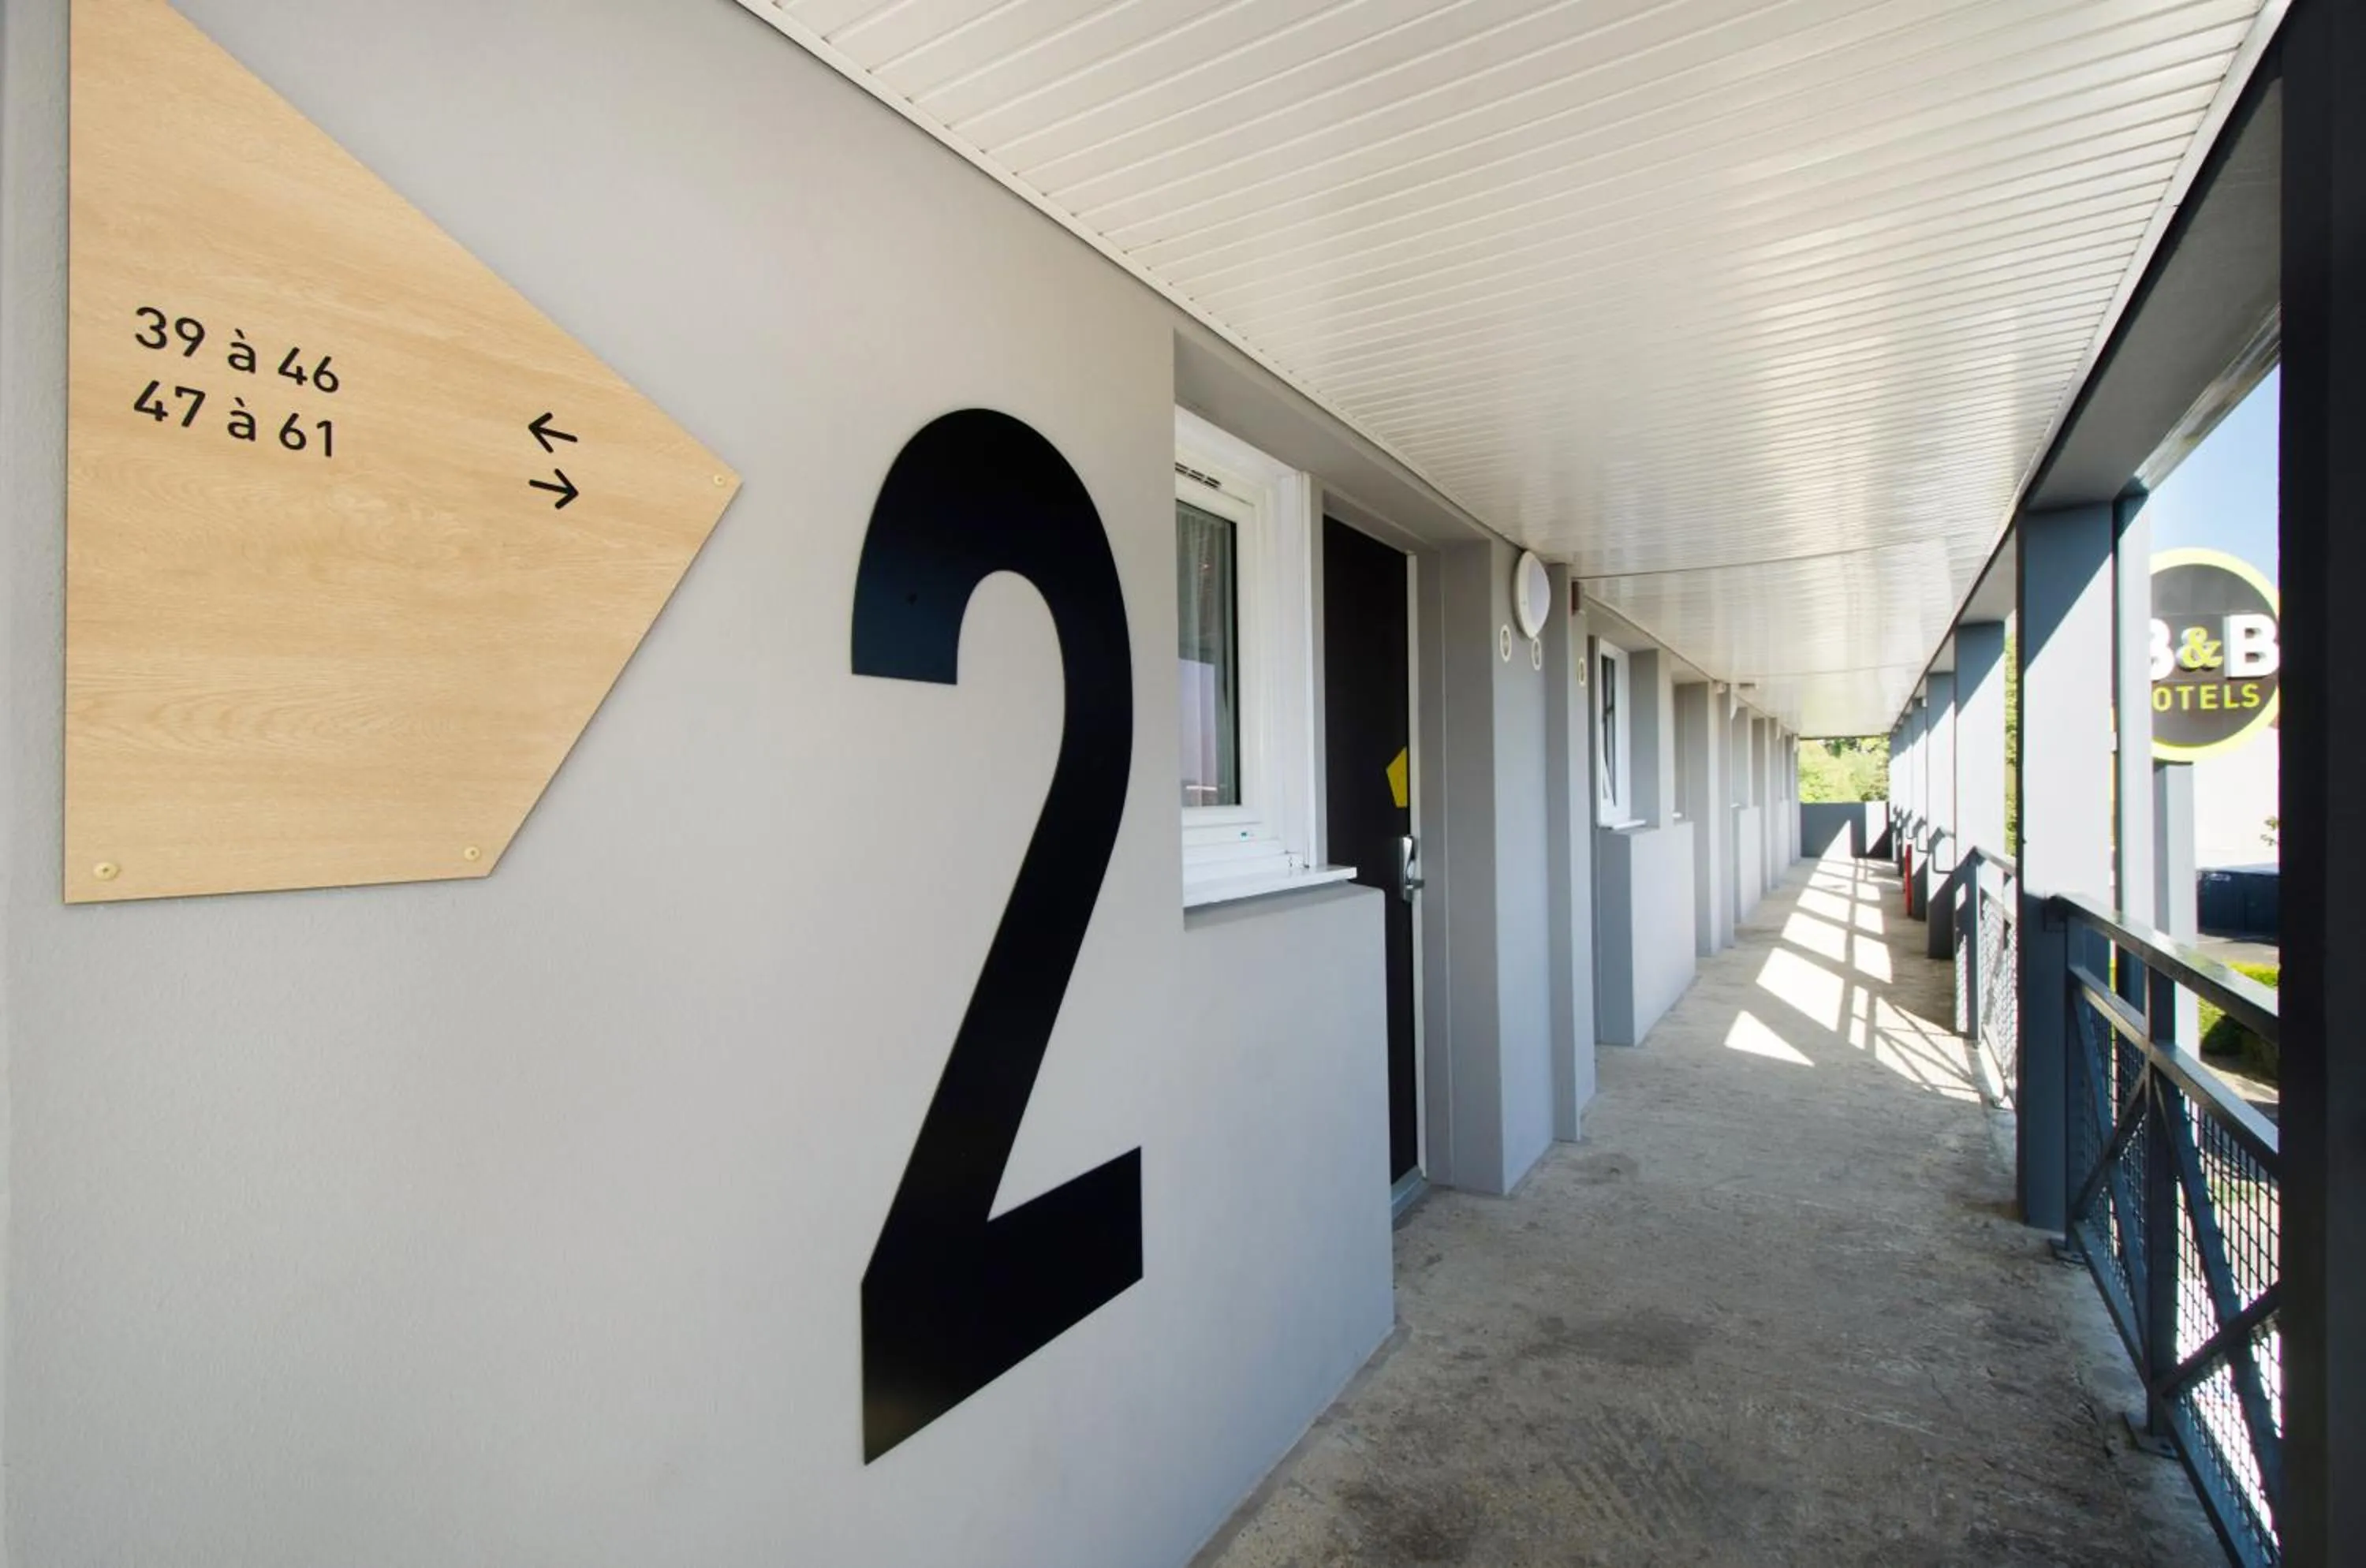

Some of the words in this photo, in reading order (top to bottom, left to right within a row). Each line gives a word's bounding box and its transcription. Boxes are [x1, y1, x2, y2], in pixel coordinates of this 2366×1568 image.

[135, 306, 206, 357] 39
[227, 328, 256, 374] à
[278, 346, 340, 394] 46
[133, 379, 207, 428] 47
[227, 397, 256, 442] à
[278, 413, 333, 457] 61
[2151, 682, 2261, 711] OTELS
[852, 408, 1144, 1465] 2
